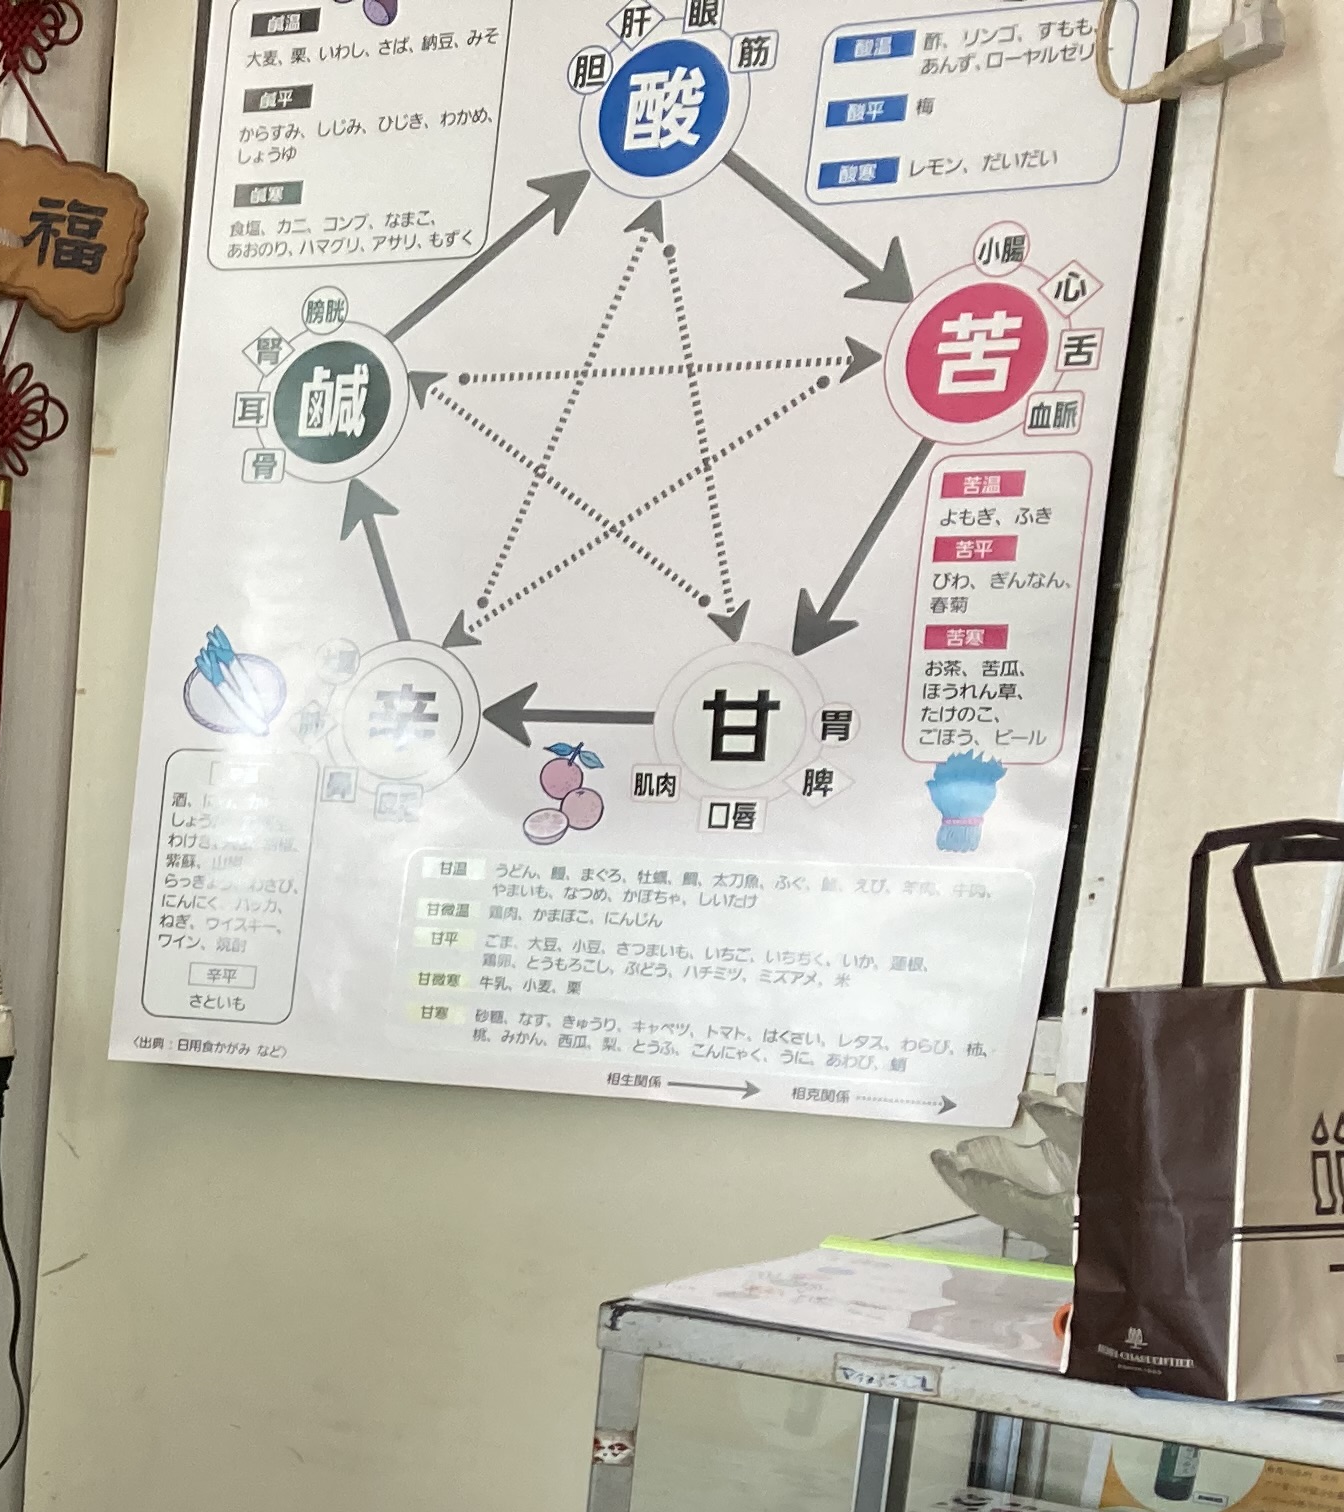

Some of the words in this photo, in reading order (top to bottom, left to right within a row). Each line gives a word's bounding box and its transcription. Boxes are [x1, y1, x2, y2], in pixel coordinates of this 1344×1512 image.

[620, 6, 653, 39] 肝
[737, 35, 770, 69] 筋
[574, 58, 606, 89] 胆
[623, 66, 706, 152] 酸
[237, 146, 297, 167] しょうゆ
[22, 197, 108, 275] 福
[977, 233, 1027, 266] 小腸
[1054, 270, 1087, 302] 心
[255, 337, 282, 367] 腎
[937, 310, 1023, 394] 苦
[1064, 334, 1098, 367] 舌
[236, 396, 264, 425] 耳
[1028, 399, 1079, 429] 血脈
[252, 451, 279, 481] 骨
[963, 475, 1003, 495] 苦温
[940, 506, 1053, 527] よもぎ、ふき
[955, 540, 994, 559] 苦平
[945, 629, 985, 648] 苦寒
[922, 682, 1025, 702] ほうれん草、
[703, 689, 780, 761] 甘
[821, 710, 853, 741] 胃
[634, 772, 676, 797] 肌肉
[802, 768, 834, 797] 脾
[708, 802, 757, 829] 口唇
